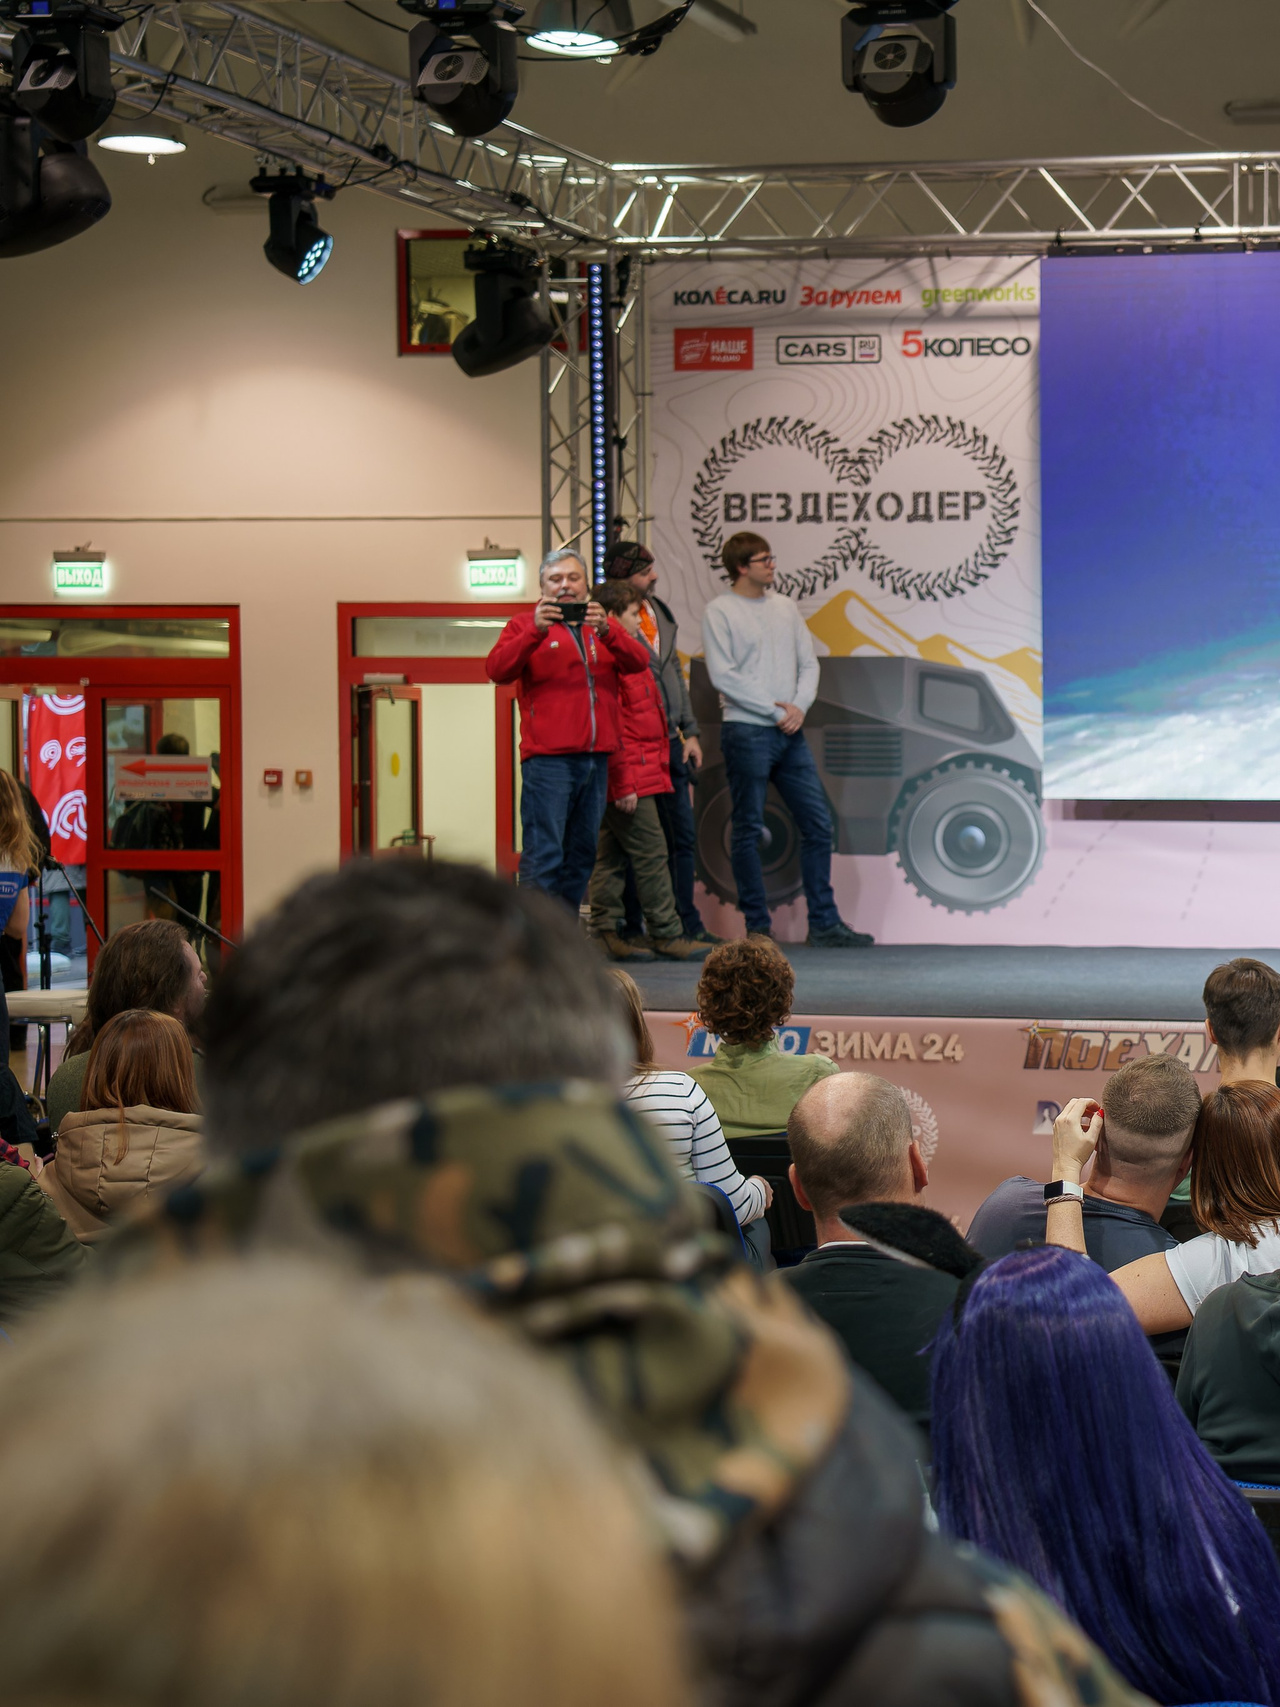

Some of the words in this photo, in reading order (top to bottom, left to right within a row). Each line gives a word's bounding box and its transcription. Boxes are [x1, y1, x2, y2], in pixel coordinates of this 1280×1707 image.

[921, 282, 1035, 308] greenworks
[711, 340, 748, 354] НАШЕ
[784, 343, 847, 357] CARS
[723, 491, 987, 523] ВЕЗДЕХОДЕР
[57, 568, 103, 587] ВЫХОД
[470, 566, 517, 586] ВЫХОД
[813, 1030, 917, 1060] ЗИМА
[922, 1033, 965, 1062] 24
